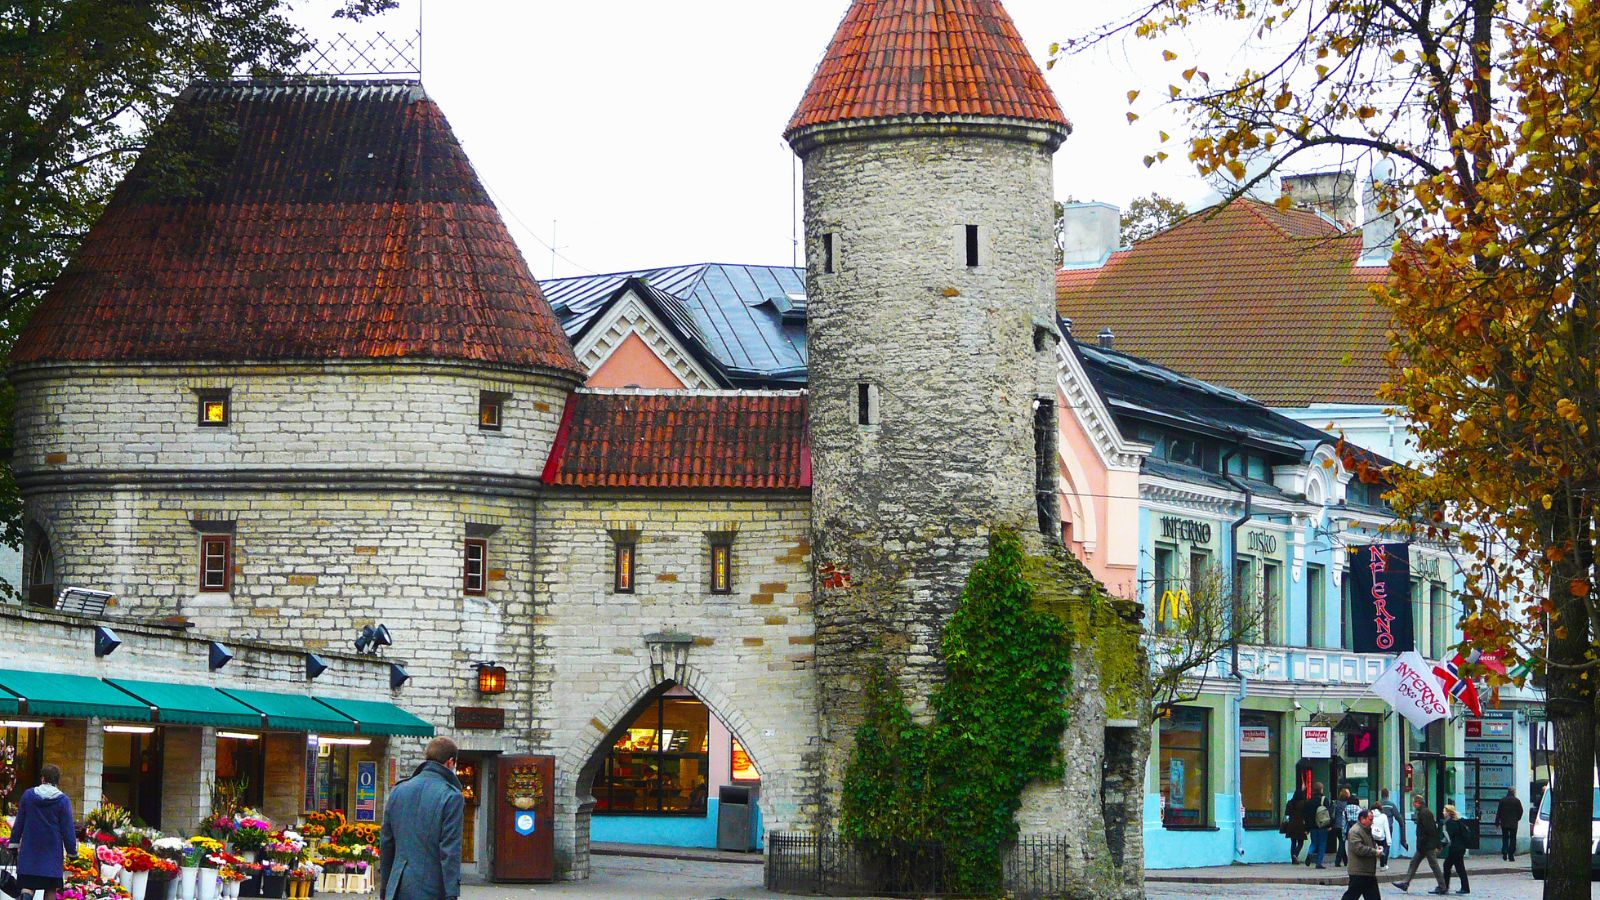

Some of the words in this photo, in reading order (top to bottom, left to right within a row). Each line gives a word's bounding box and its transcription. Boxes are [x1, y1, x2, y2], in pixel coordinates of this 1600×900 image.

[1160, 516, 1211, 551] INFERNO
[1248, 530, 1276, 554] DISKO
[1395, 661, 1446, 714] INFERNO
